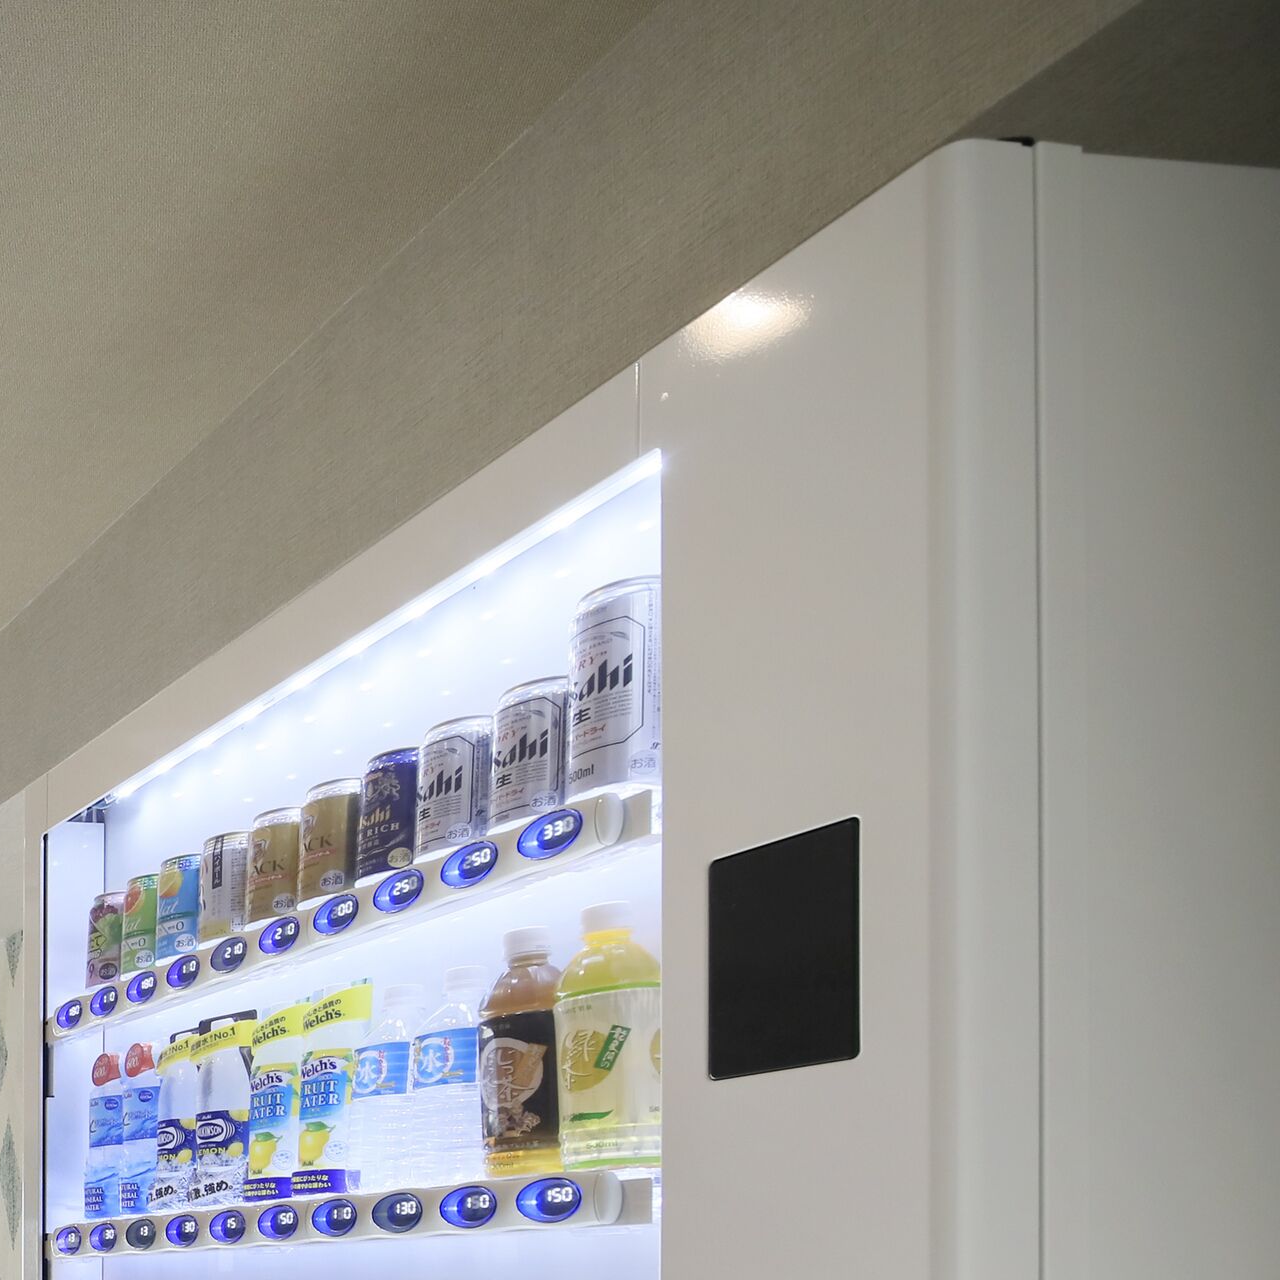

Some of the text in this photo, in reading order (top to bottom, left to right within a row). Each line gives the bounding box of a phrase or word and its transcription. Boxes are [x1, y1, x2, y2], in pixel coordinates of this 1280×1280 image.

[103, 991, 115, 1003] 10
[546, 1188, 574, 1204] 150
[333, 1206, 352, 1220] 10
[395, 1202, 416, 1215] 130
